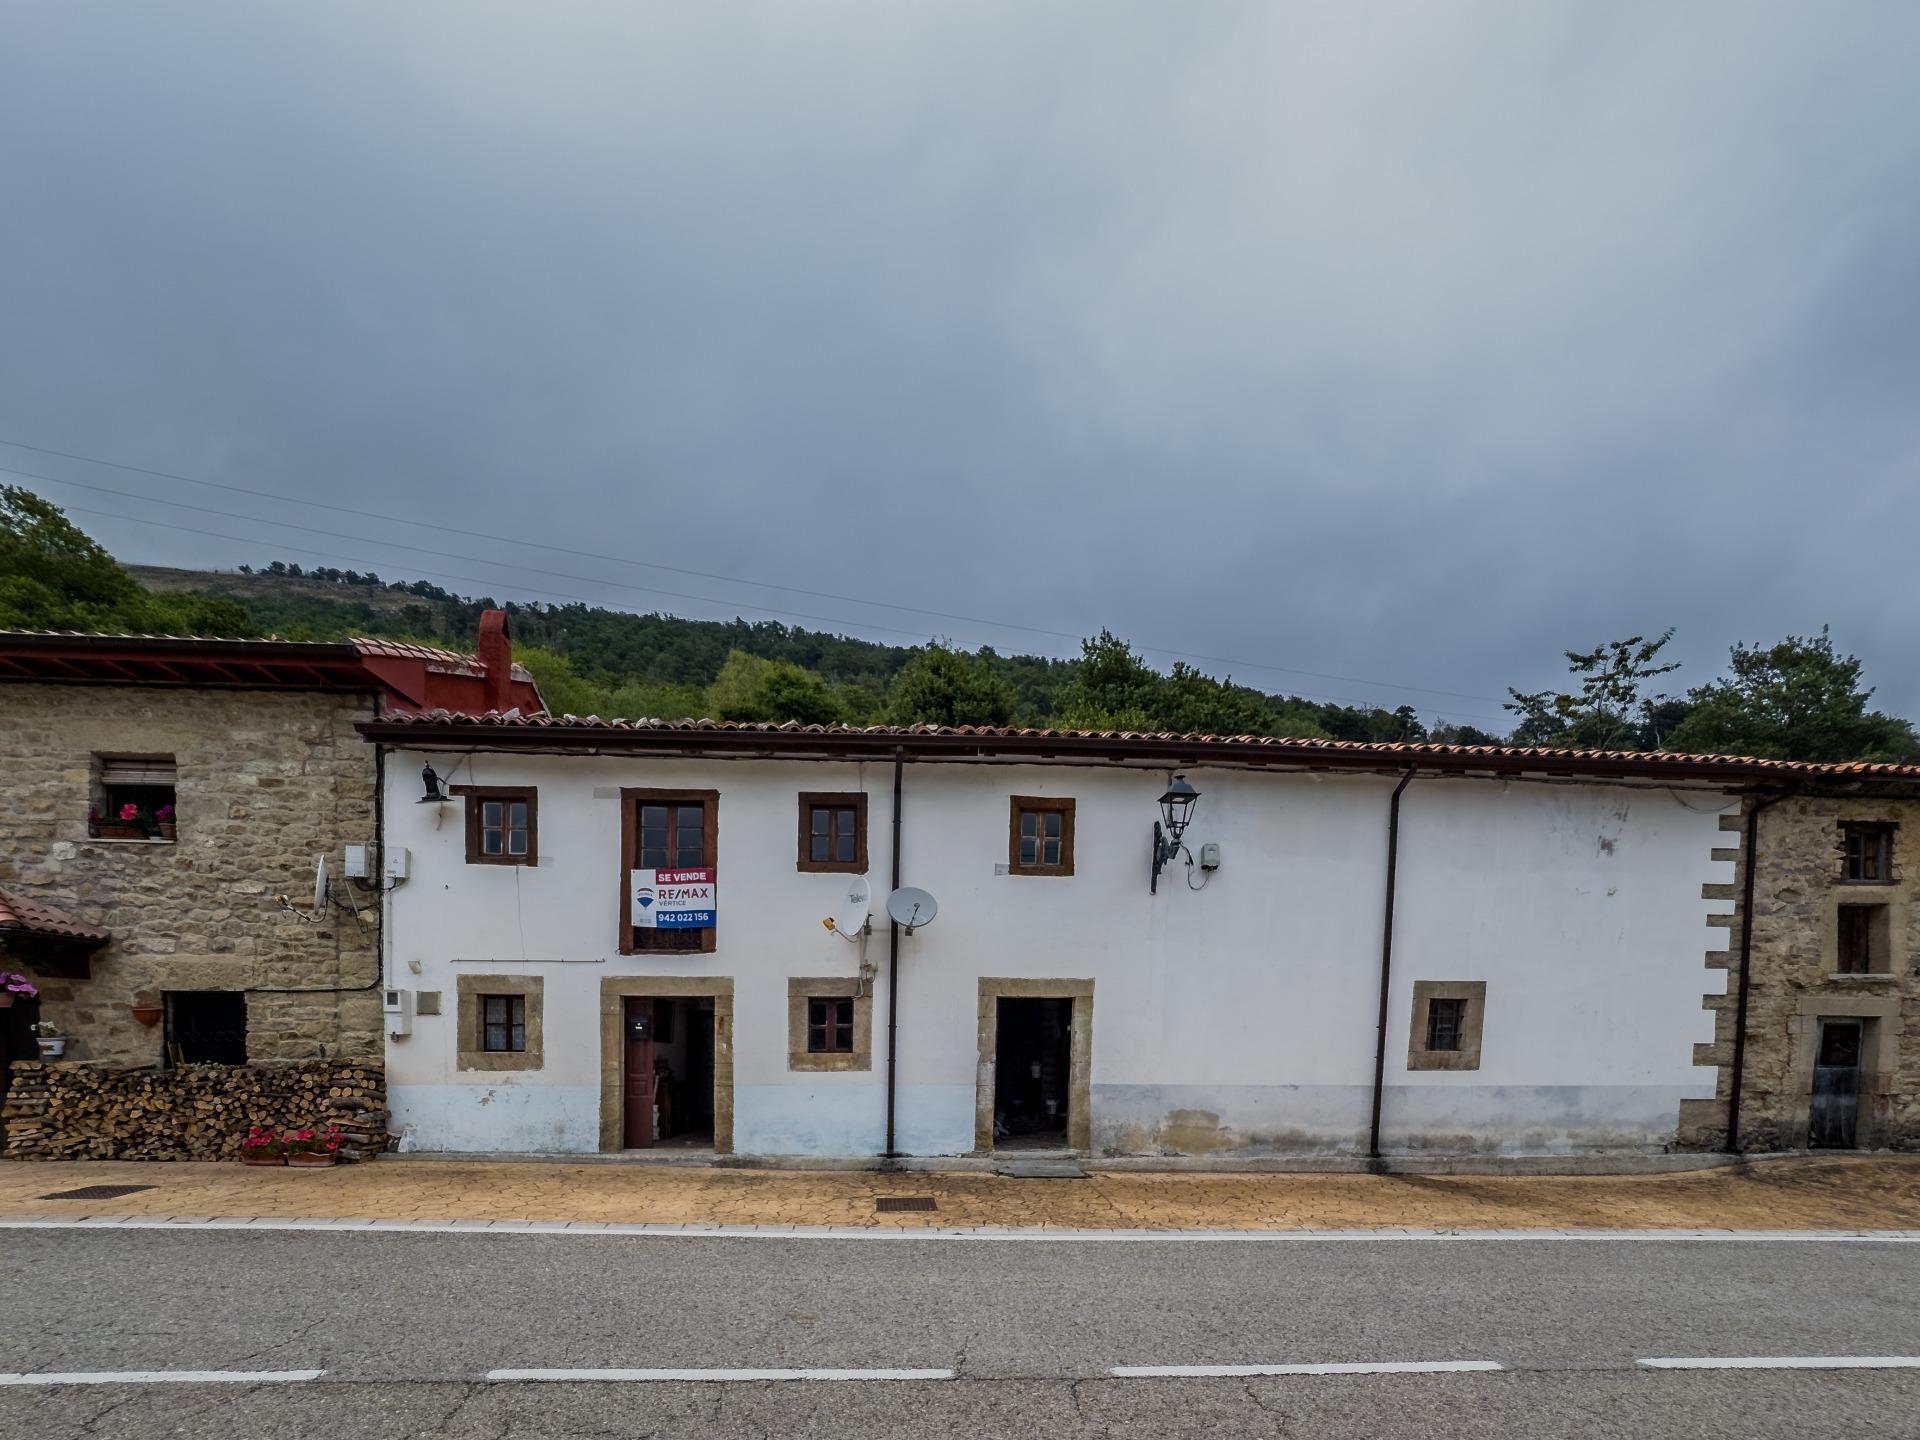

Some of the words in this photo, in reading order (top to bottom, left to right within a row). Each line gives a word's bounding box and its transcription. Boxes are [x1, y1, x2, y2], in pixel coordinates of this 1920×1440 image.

[658, 873, 671, 882] SE
[673, 872, 706, 881] VENDE
[658, 888, 708, 899] RE/MAX
[658, 914, 675, 922] 942
[677, 913, 692, 922] 022
[694, 912, 709, 921] 156
